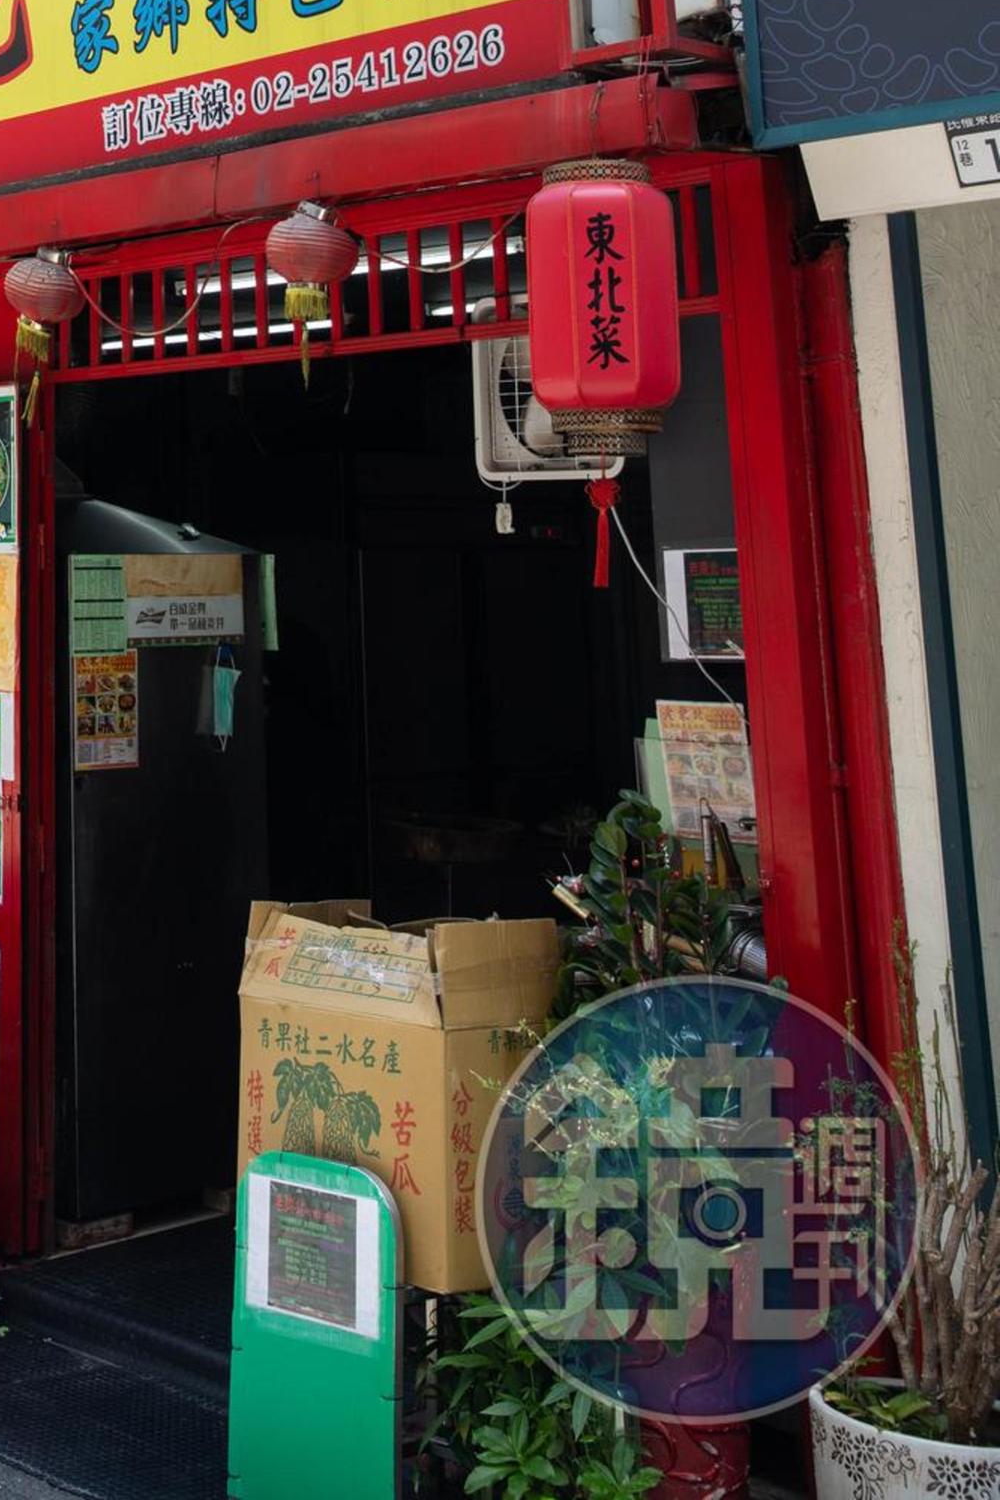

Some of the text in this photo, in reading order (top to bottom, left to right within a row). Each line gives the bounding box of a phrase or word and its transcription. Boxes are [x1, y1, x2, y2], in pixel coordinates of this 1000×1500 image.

[585, 211, 630, 370] 東北菜
[257, 1017, 403, 1074] 青果社二水名產
[390, 1100, 423, 1197] 苦瓜
[449, 1081, 477, 1236] 分級包裝
